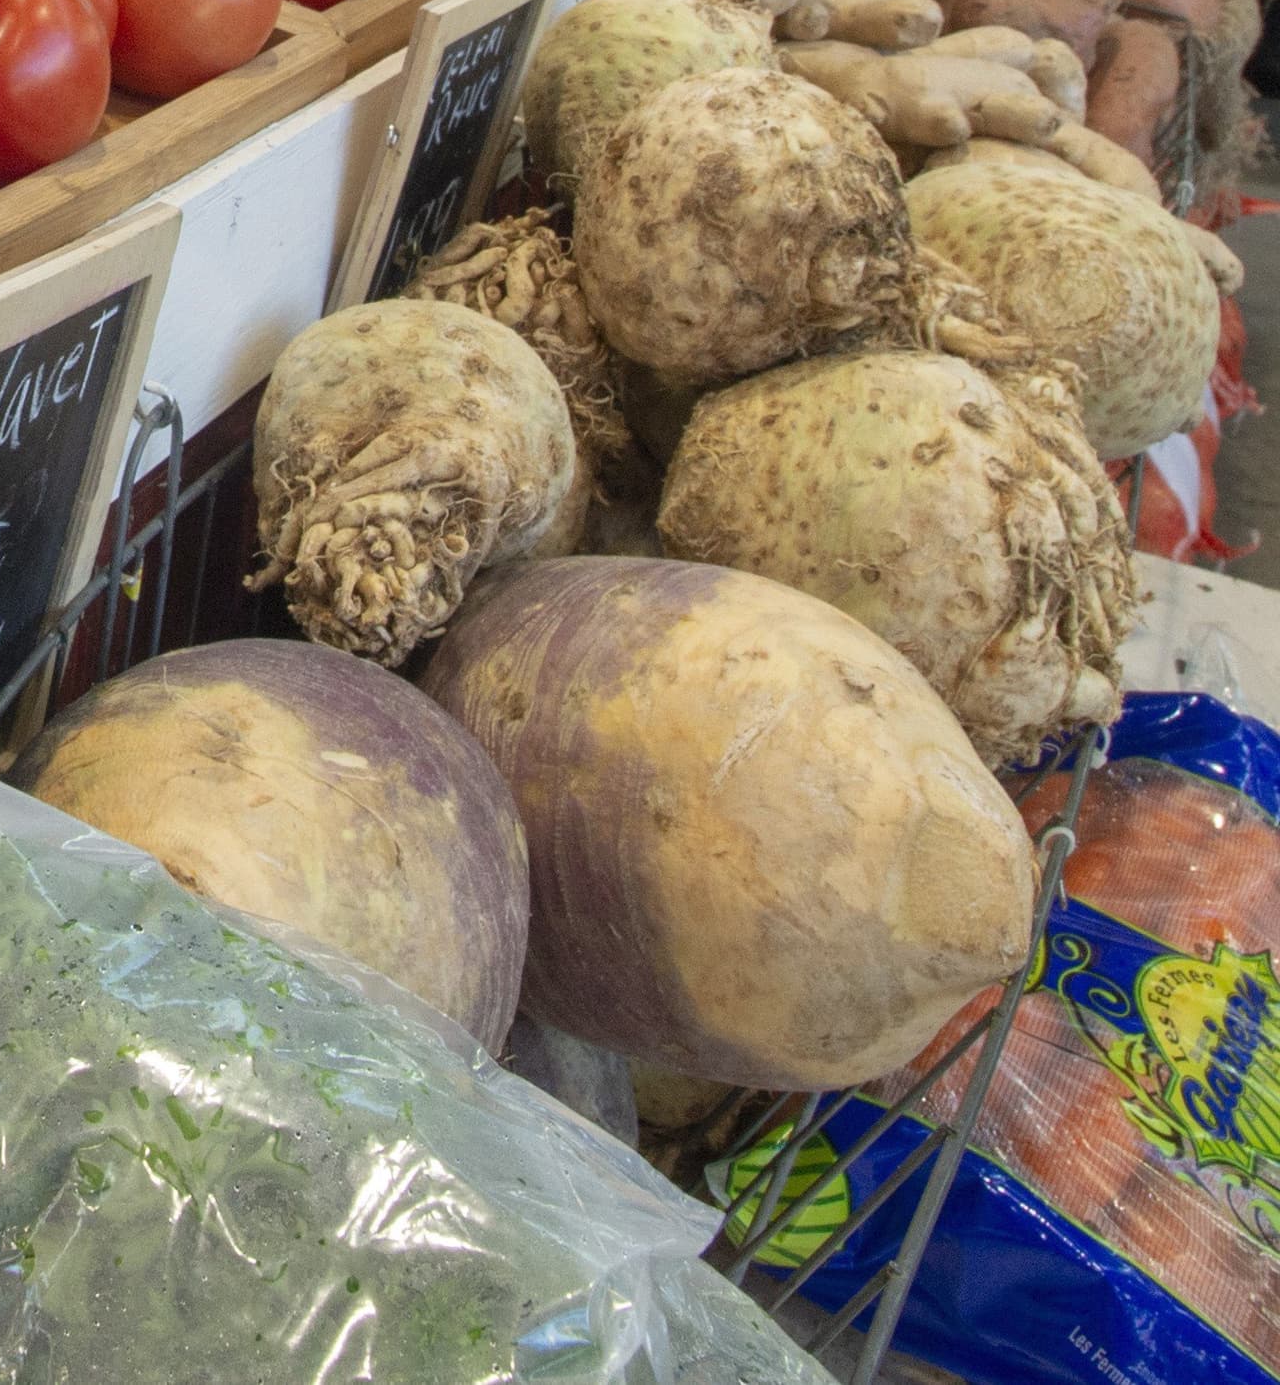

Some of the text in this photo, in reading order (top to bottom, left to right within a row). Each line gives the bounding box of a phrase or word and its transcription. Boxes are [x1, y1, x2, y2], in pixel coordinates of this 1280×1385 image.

[1147, 968, 1216, 1064] Les Fermes
[1067, 1325, 1095, 1354] Les
[1091, 1347, 1139, 1385] Ferme
